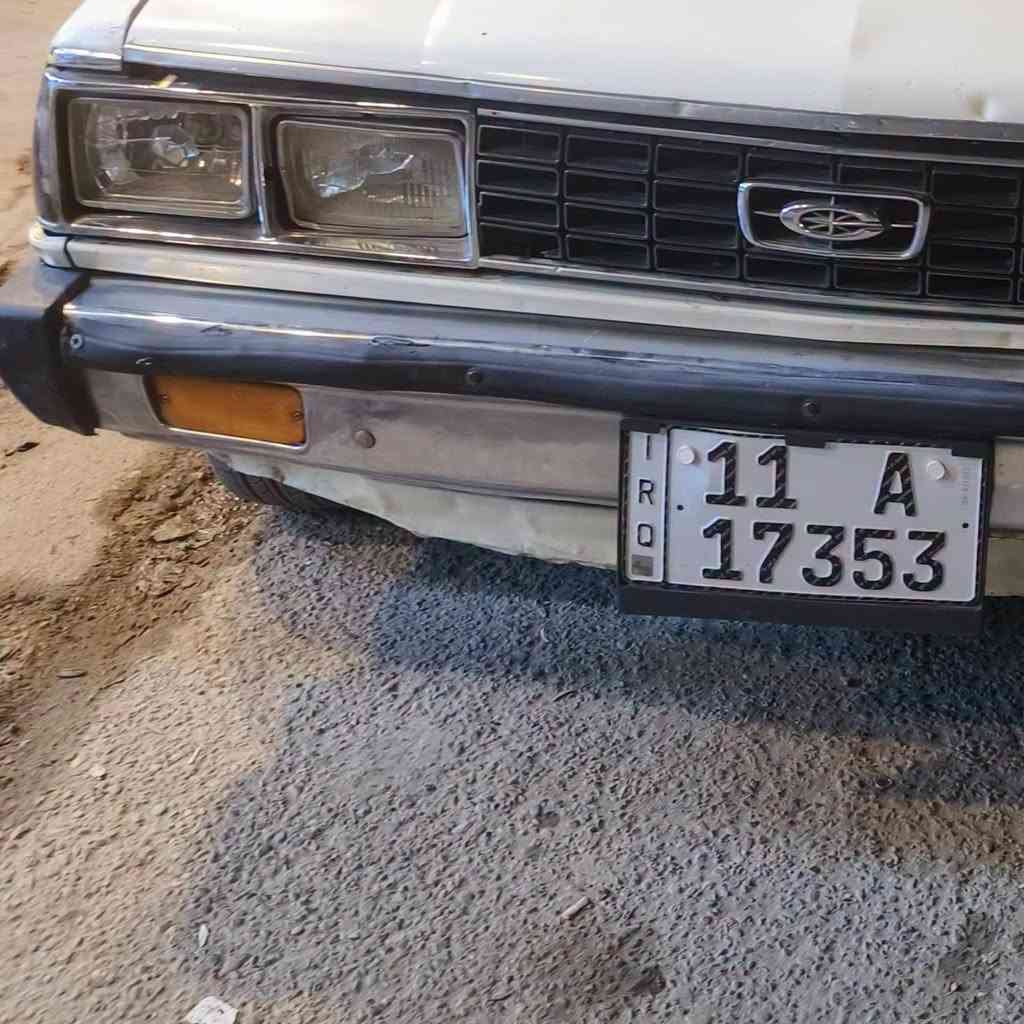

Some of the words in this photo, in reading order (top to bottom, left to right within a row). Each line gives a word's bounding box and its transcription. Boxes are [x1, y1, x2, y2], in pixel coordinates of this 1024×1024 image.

[705, 440, 798, 509] 11
[873, 451, 918, 517] A
[702, 517, 947, 592] 17353
